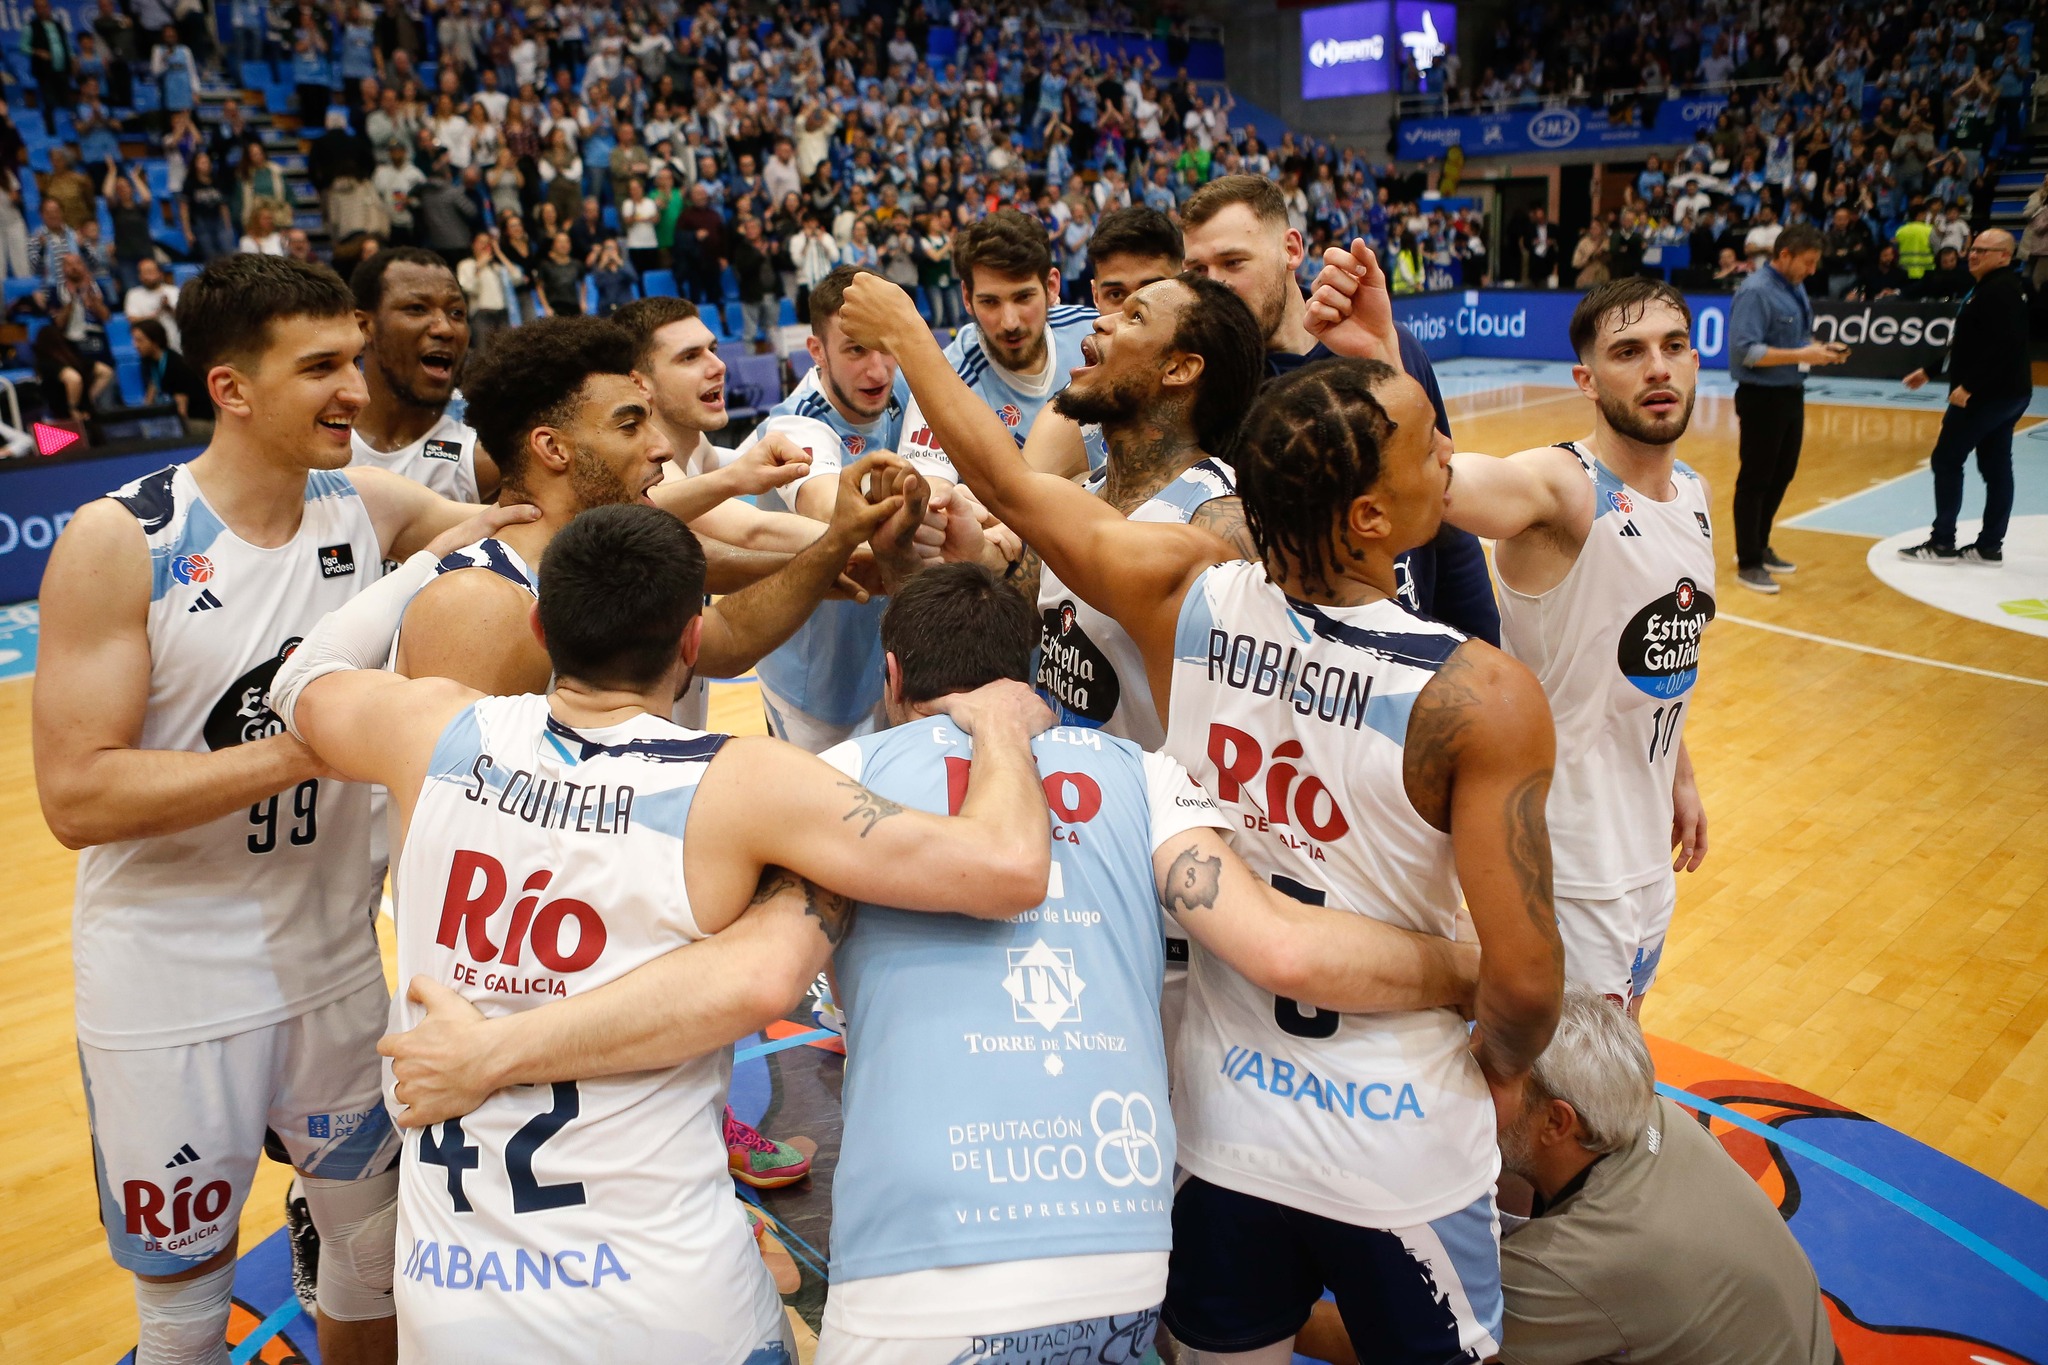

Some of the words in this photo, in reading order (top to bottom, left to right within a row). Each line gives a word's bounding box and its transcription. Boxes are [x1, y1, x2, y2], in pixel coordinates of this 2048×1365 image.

[1536, 119, 1572, 137] 2M2
[1455, 307, 1526, 338] Cloud
[1811, 307, 1956, 347] ndesa
[321, 556, 338, 567] liga
[324, 562, 354, 575] endesa
[932, 726, 958, 746] E.
[1648, 701, 1683, 764] 10
[465, 754, 494, 806] S.
[1206, 722, 1351, 843] Río
[247, 777, 319, 854] 99
[1243, 814, 1270, 833] DE
[435, 849, 608, 973] Río
[1043, 906, 1059, 924] de
[1063, 908, 1102, 928] Lugo
[453, 962, 477, 987] DE
[484, 973, 568, 997] GALICIA
[1234, 1050, 1425, 1122] ABANCA
[419, 1080, 587, 1214] 42
[949, 1116, 1082, 1145] DEPUTACIÓN
[951, 1149, 982, 1172] DE
[985, 1143, 1088, 1184] LUGO
[123, 1176, 233, 1239] Río
[956, 1199, 1164, 1224] VICEPRESIDENCIA
[144, 1241, 163, 1252] DE
[167, 1223, 220, 1251] GALICIA
[414, 1239, 632, 1292] ABANCA
[972, 1320, 1099, 1357] DEPUTACIÓN
